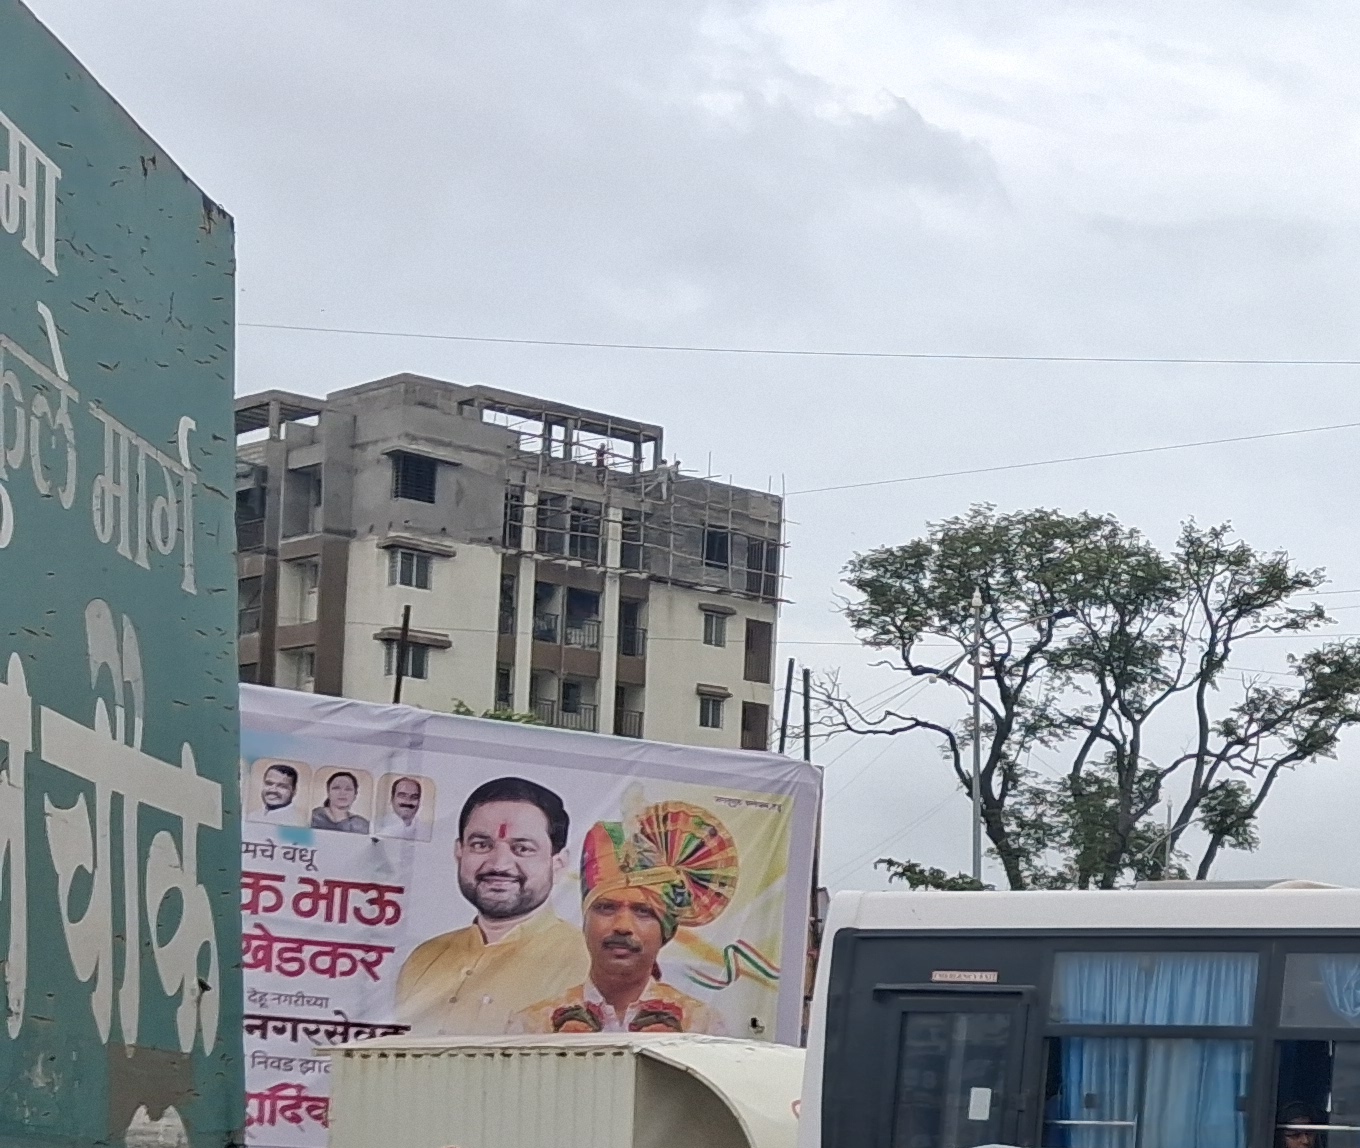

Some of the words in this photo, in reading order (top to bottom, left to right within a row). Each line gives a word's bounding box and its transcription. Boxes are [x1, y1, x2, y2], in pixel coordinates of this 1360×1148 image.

[88, 400, 198, 595] मार्ग
[40, 598, 223, 1058] चौक
[292, 876, 405, 927] भाऊ
